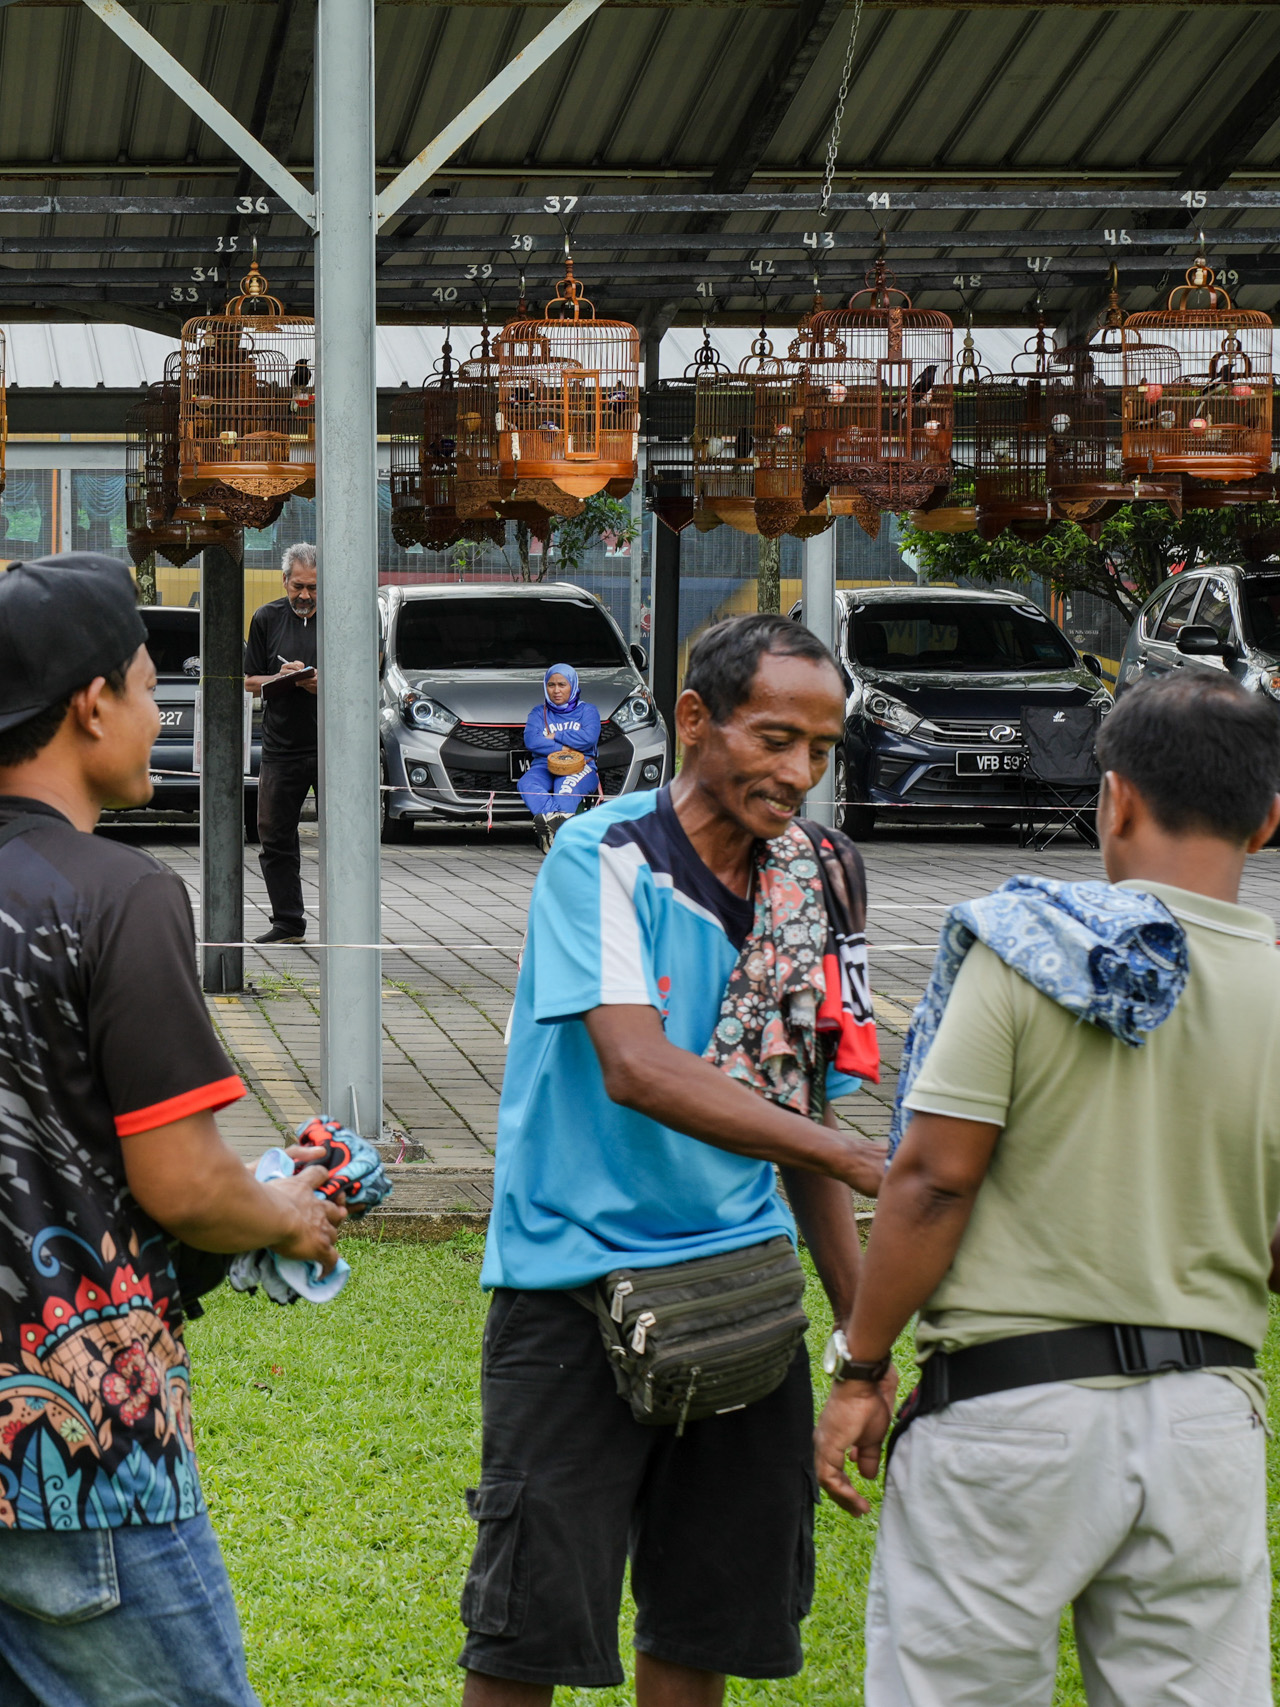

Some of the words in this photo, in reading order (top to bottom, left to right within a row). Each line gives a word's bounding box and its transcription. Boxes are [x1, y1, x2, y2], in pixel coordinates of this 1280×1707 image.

[236, 197, 270, 214] 36
[543, 196, 578, 213] 37
[867, 192, 891, 209] 44
[1180, 191, 1207, 208] 45
[216, 236, 239, 252] 35
[510, 234, 534, 250] 38
[803, 232, 835, 248] 43
[1104, 229, 1133, 245] 46
[464, 264, 492, 279] 39
[750, 260, 775, 275] 42
[1027, 257, 1054, 271] 47
[191, 266, 219, 281] 34
[1215, 270, 1238, 284] 49
[952, 275, 981, 288] 48
[170, 288, 200, 301] 33
[432, 287, 458, 301] 40
[695, 282, 714, 297] 41
[976, 755, 1000, 770] VFB
